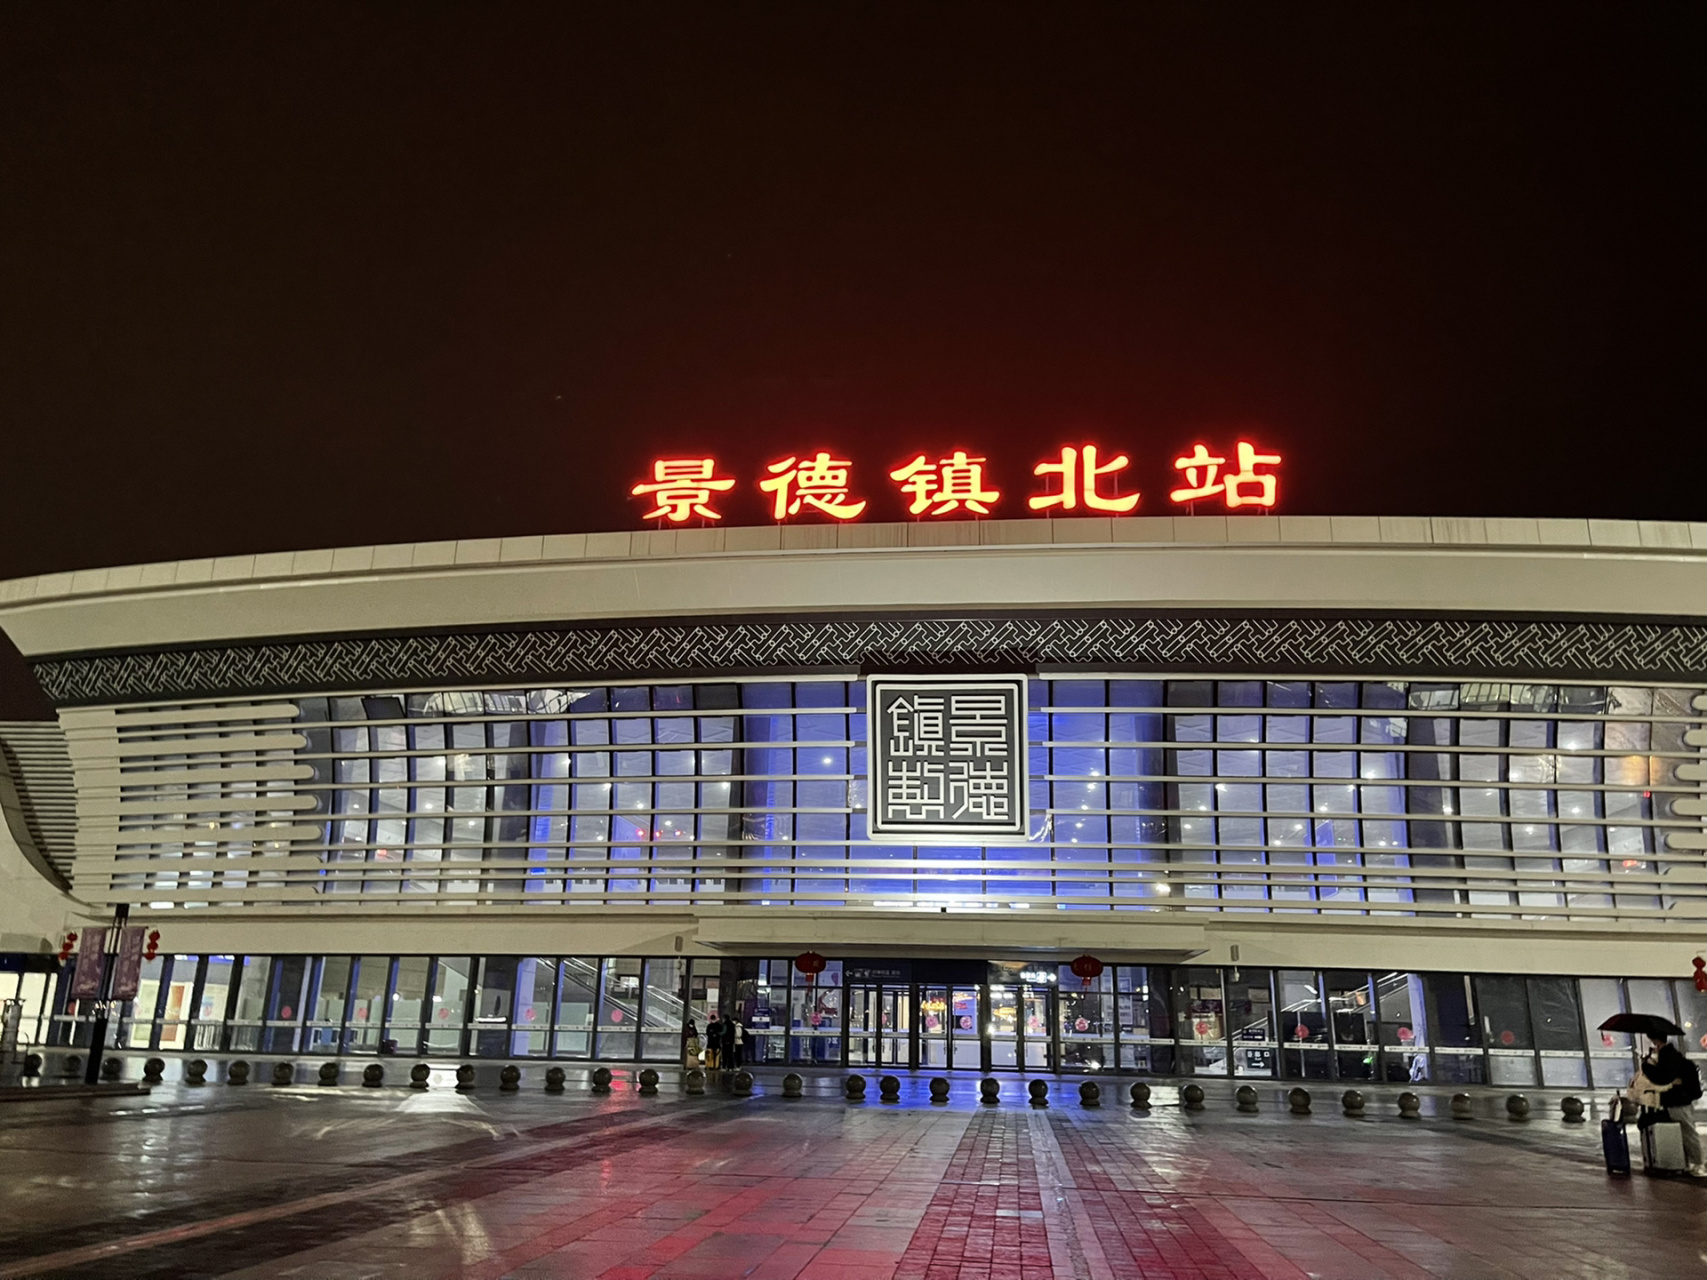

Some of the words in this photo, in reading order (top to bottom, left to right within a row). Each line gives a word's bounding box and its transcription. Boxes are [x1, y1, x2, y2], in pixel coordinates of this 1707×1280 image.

[632, 441, 1281, 521] 景德镇北站
